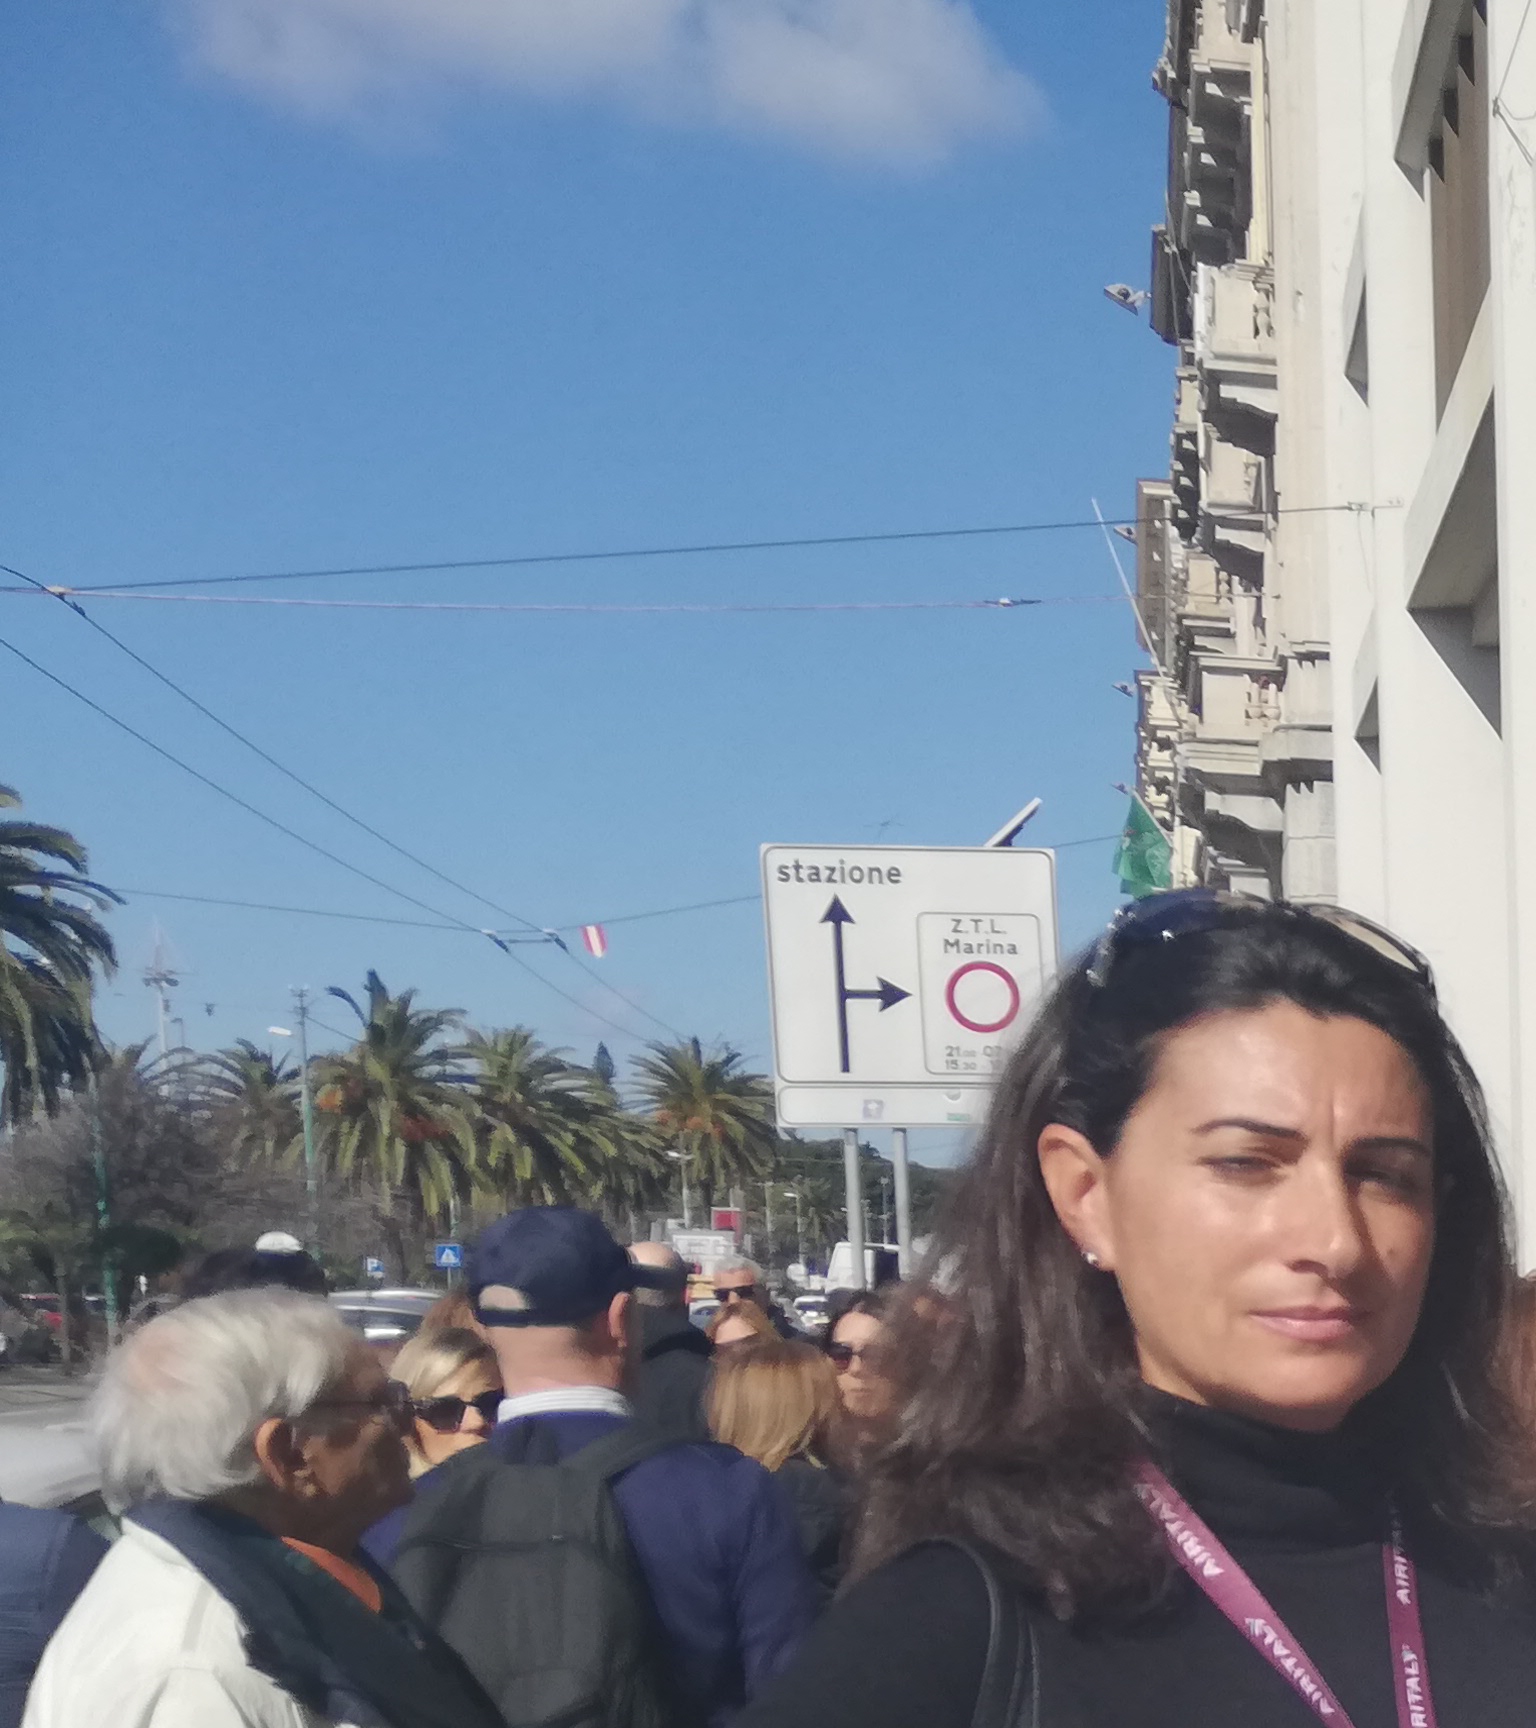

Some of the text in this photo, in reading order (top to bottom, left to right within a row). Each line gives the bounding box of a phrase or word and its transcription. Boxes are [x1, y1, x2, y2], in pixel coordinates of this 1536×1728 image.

[776, 859, 902, 885] stazione
[950, 918, 1008, 935] Z.T.L.
[943, 938, 1018, 955] Marina
[1245, 1617, 1336, 1716] AIRITALY
